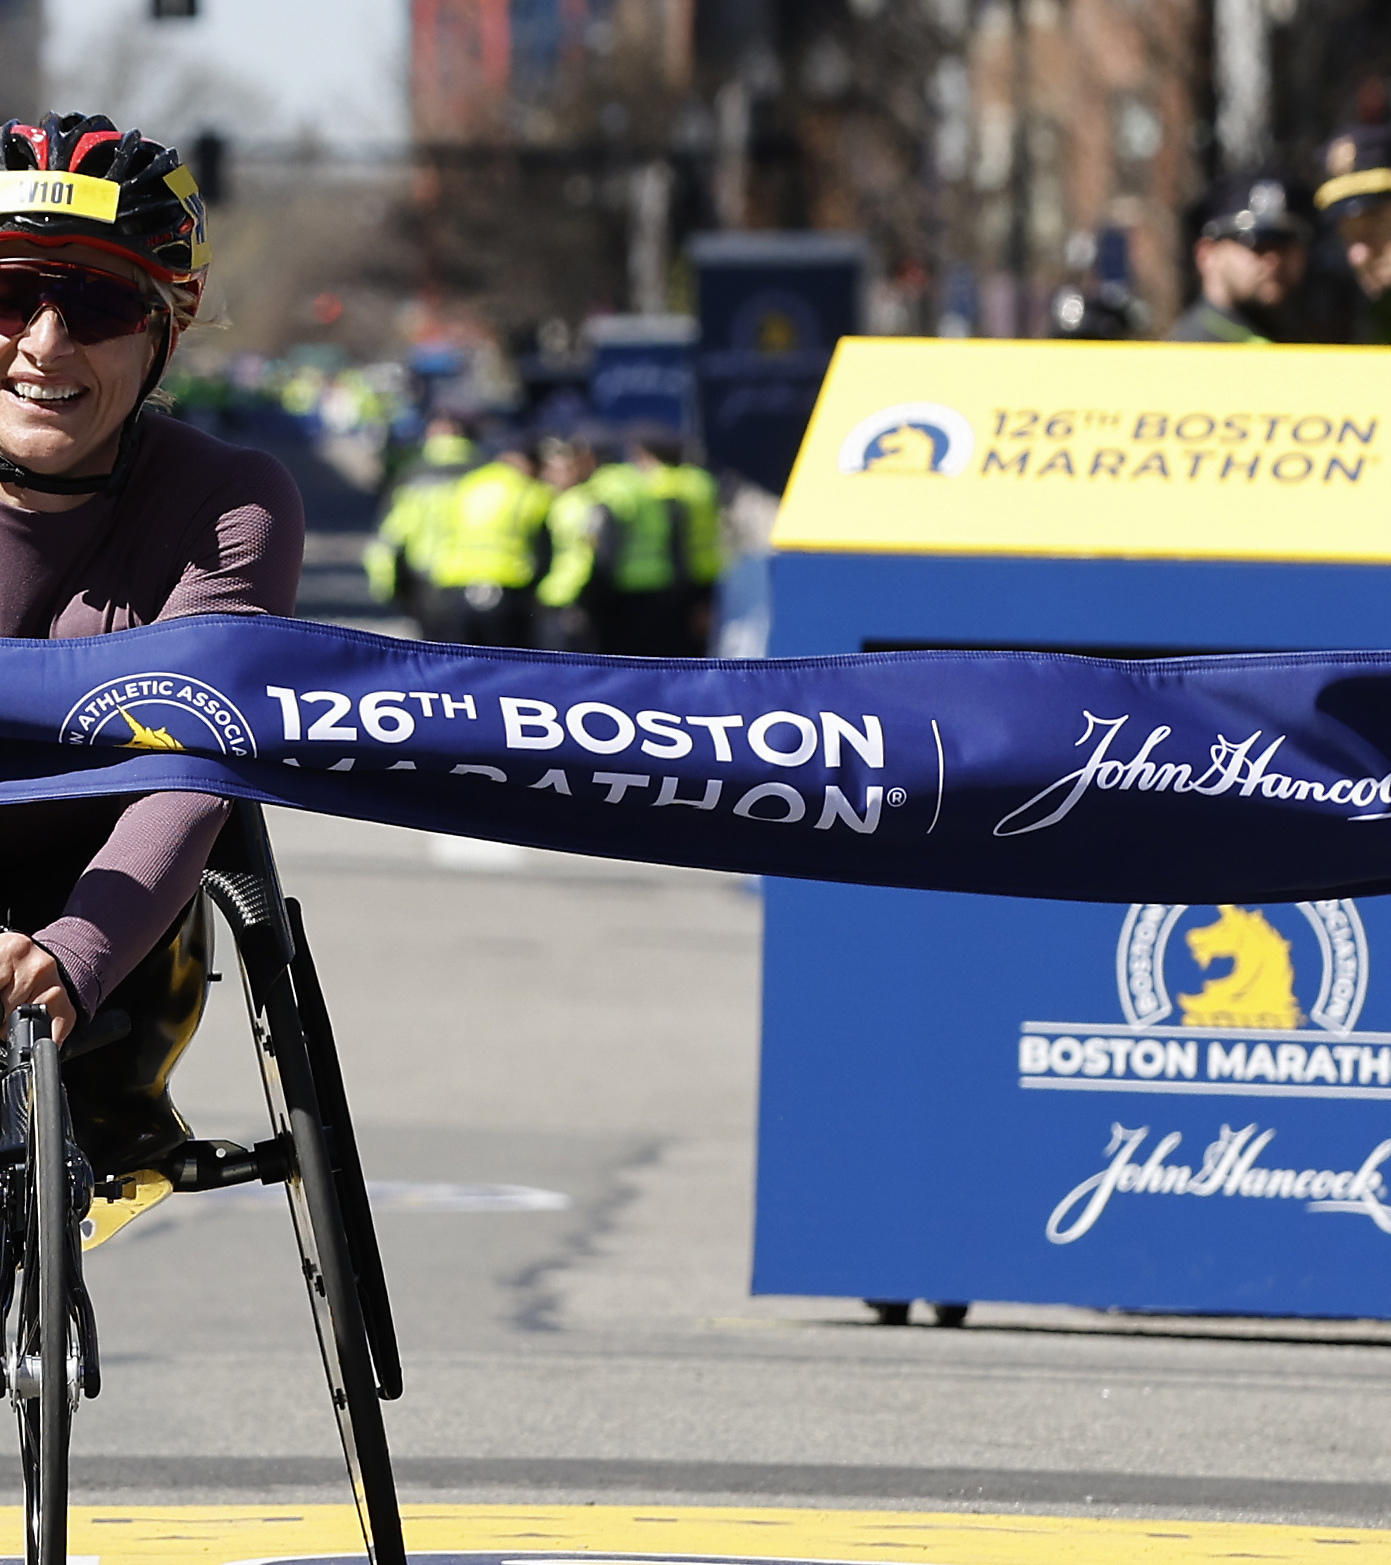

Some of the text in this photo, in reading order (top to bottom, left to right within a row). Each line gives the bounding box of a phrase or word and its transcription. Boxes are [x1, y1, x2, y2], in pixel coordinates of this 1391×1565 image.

[1133, 411, 1377, 446] BOSTON
[980, 448, 1367, 485] MARATHON
[78, 680, 174, 732] ATHLETIC
[266, 685, 885, 769] 126TH BOSTON
[993, 710, 1192, 837] John
[1019, 1035, 1390, 1086] BOSTON MARATH
[1046, 1121, 1194, 1245] John
